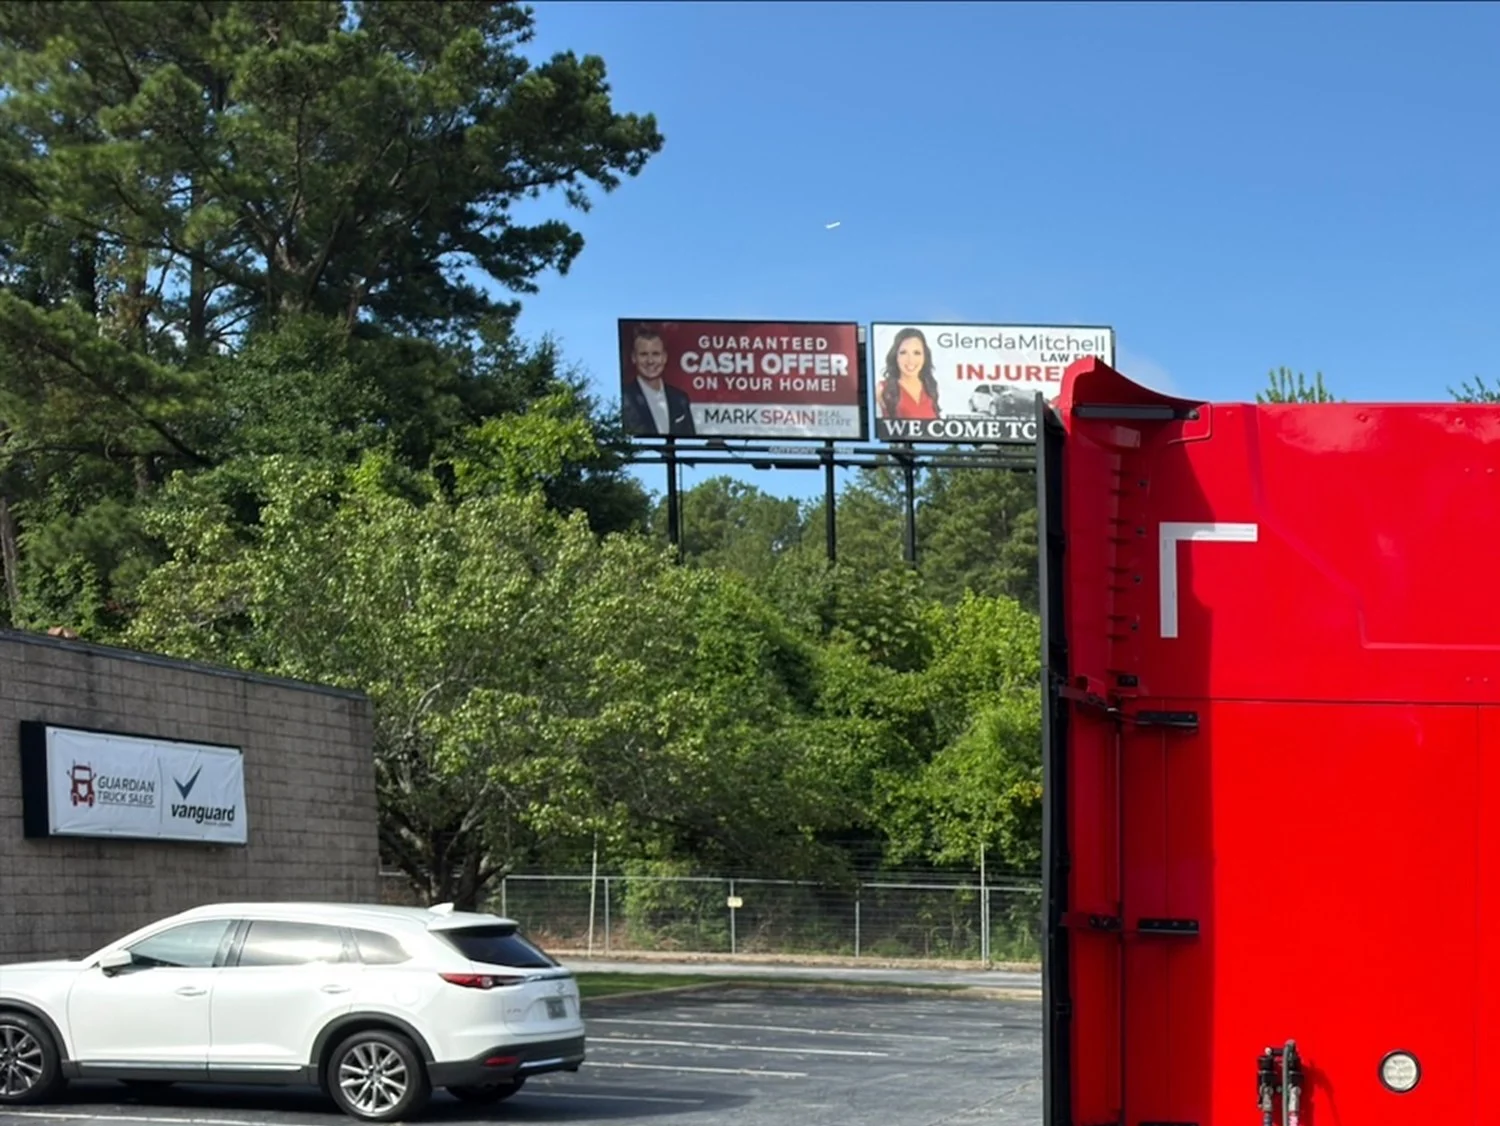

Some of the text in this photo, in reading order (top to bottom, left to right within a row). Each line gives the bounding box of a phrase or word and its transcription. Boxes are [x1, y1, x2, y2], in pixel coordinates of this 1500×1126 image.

[698, 335, 828, 350] GUARANTEED
[680, 352, 849, 376] CASH OFFER
[1041, 353, 1070, 362] LAW
[956, 364, 1066, 382] INJURE
[693, 377, 836, 392] ON YOUR HOME!
[704, 408, 816, 425] MARK SPAIN
[883, 419, 922, 437] WE
[927, 419, 1001, 438] COME
[98, 776, 155, 793] GUARDIAN
[98, 791, 154, 805] TRUCK SALES
[171, 803, 236, 824] vanguard
